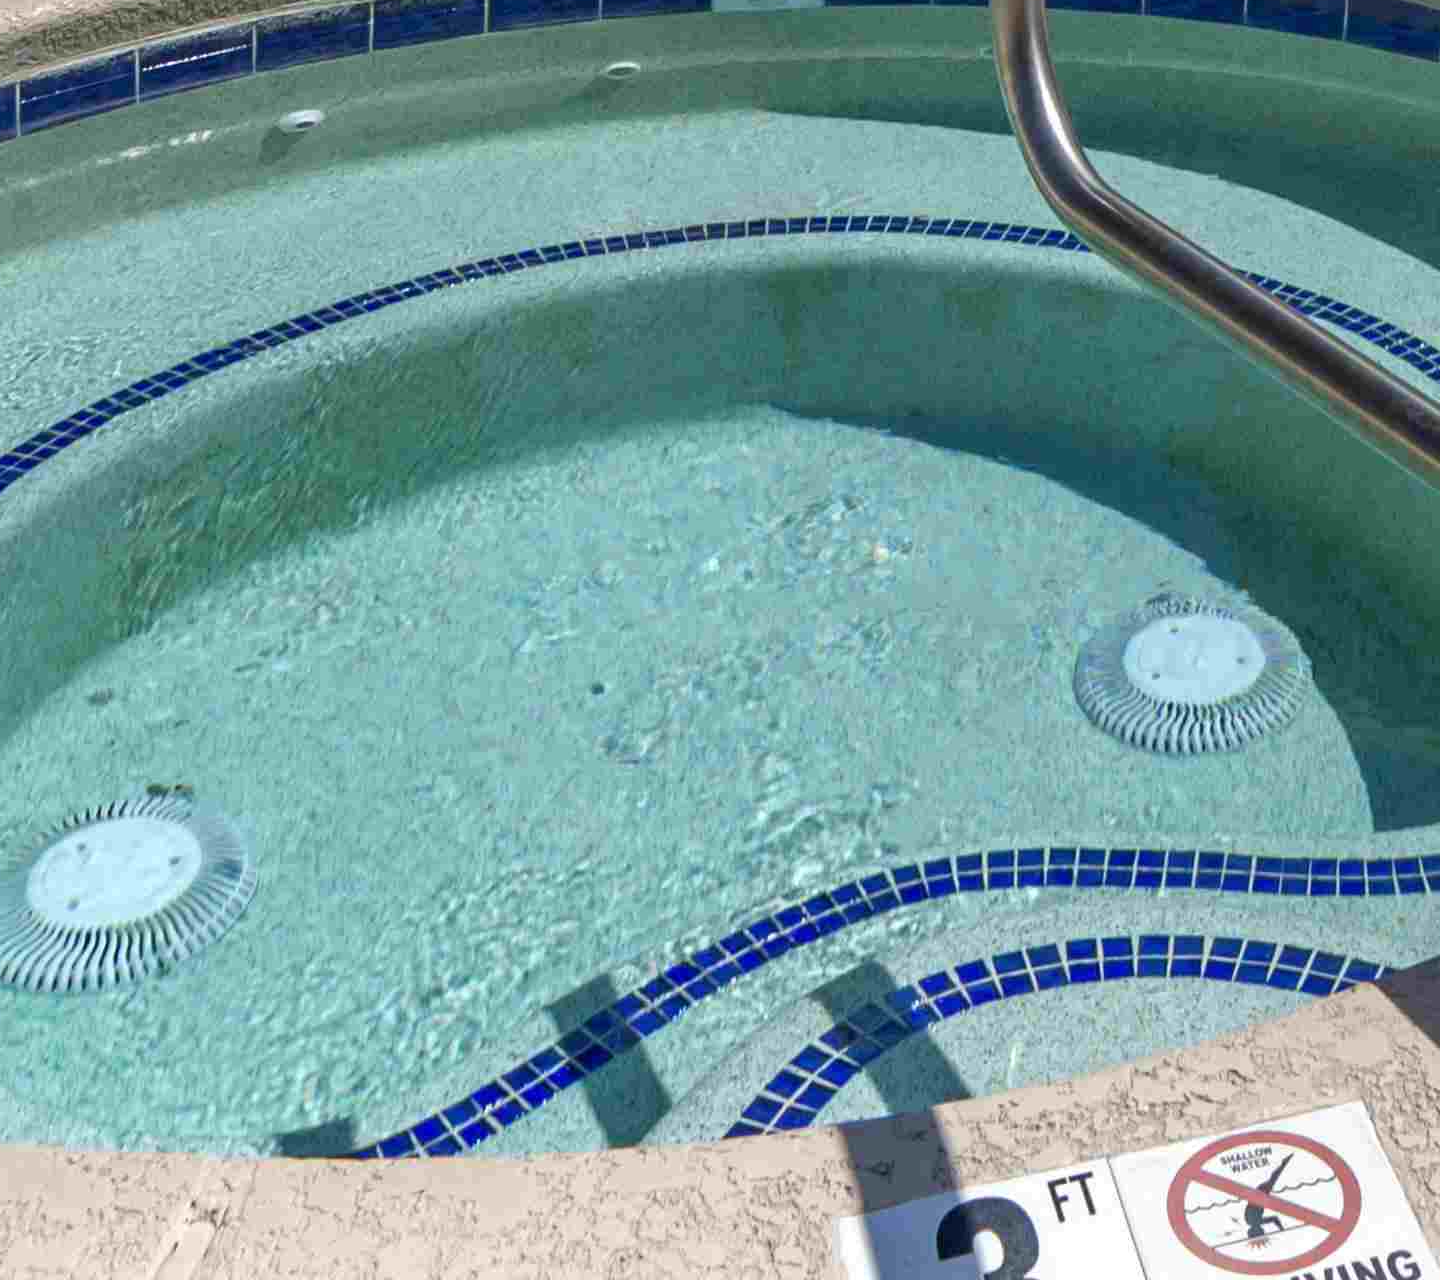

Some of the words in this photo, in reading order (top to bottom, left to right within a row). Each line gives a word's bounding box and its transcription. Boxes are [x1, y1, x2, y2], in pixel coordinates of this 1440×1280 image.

[1220, 1146, 1272, 1165] SHALLOW
[1232, 1157, 1270, 1173] WATER
[1048, 1171, 1097, 1224] FT
